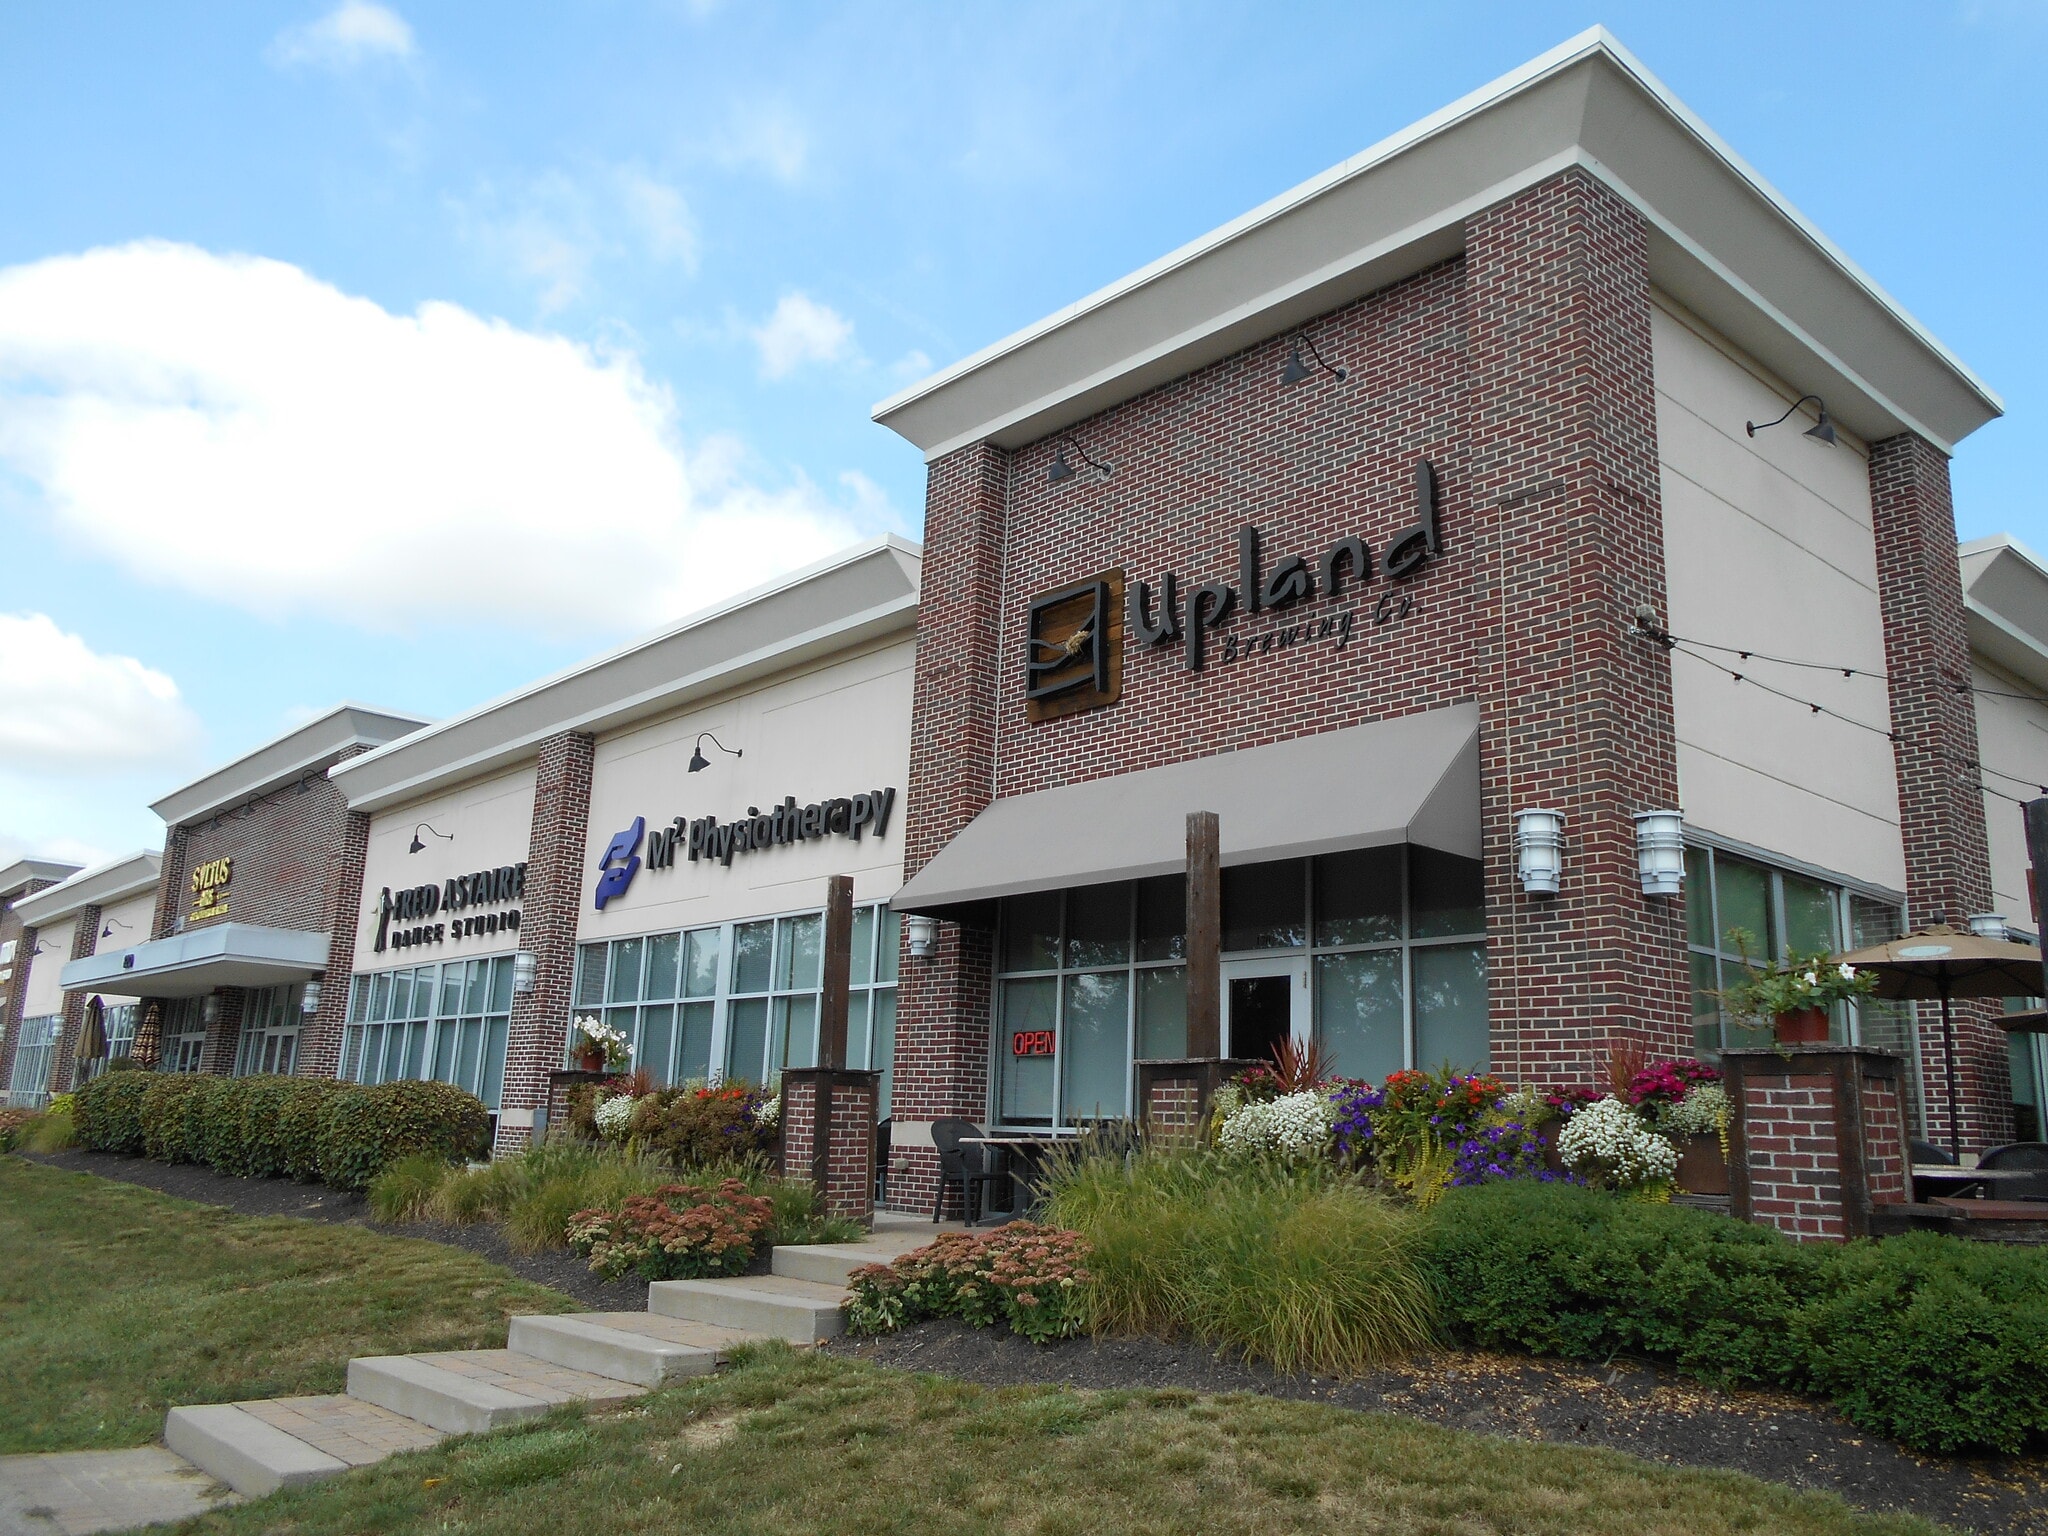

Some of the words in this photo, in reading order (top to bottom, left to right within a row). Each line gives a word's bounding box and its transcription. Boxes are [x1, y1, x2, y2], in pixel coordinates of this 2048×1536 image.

[1222, 611, 1353, 663] Brewing
[1374, 591, 1423, 624] Co.
[688, 787, 896, 867] Physiotherapy
[392, 884, 440, 921] FRED
[440, 862, 528, 911] ASTAIRE
[391, 923, 446, 949] DANCE
[451, 909, 522, 940] STUDIO
[1014, 1031, 1056, 1055] OPEN
